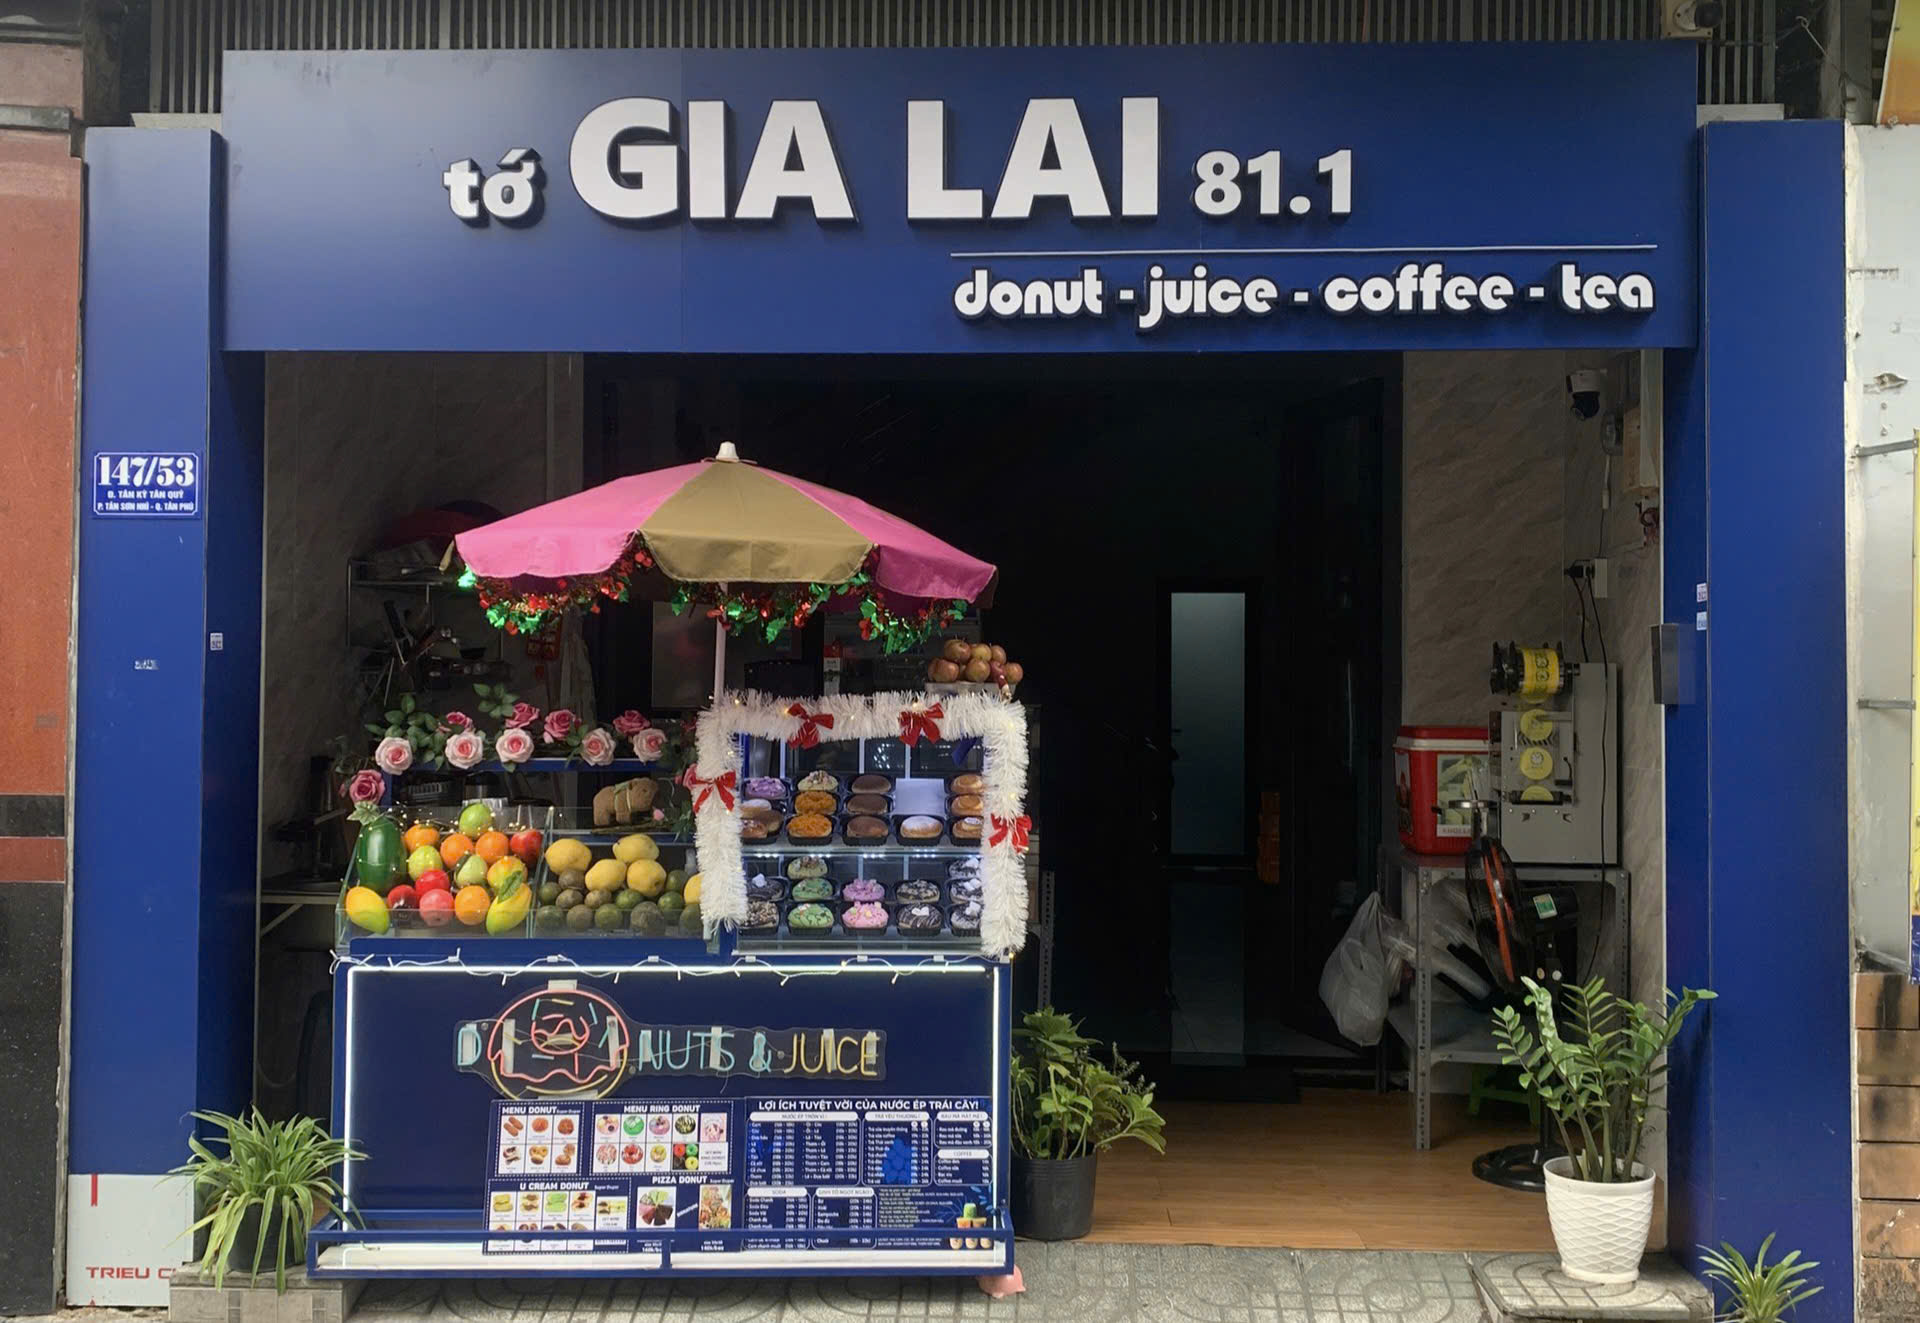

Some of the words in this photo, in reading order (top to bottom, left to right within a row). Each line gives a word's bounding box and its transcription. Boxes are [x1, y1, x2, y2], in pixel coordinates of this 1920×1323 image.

[443, 148, 536, 218] tớ
[570, 98, 855, 219] GIA
[907, 97, 1159, 219] LAI
[1193, 149, 1352, 215] 81.1
[954, 269, 1103, 316] donut
[1139, 265, 1278, 329] juice
[1324, 264, 1515, 312] coffee
[1562, 264, 1653, 310] tea
[98, 456, 195, 487] 147/53
[118, 489, 135, 499] TÂN
[149, 489, 166, 499] TÂN
[97, 502, 104, 511] P.
[105, 501, 119, 511] TÂN
[120, 502, 135, 511] SƠN
[164, 501, 178, 511] TÂN
[783, 1030, 881, 1076] JUICE
[501, 1106, 527, 1115] MENU
[528, 1106, 558, 1114] DONUT
[623, 1105, 648, 1113] MENU
[649, 1104, 670, 1113] RING
[671, 1104, 701, 1113] DONUT
[758, 1101, 776, 1112] LỢI
[779, 1099, 797, 1110] ÍCH
[799, 1099, 832, 1112] TUYỆT
[834, 1099, 853, 1110] VỜI
[855, 1099, 878, 1110] CỦA
[879, 1099, 910, 1110] NƯỚC
[912, 1099, 927, 1110] ÉP
[929, 1099, 953, 1110] TRÁI
[955, 1099, 979, 1110] CÂY!
[652, 1175, 677, 1184] PIZZA
[678, 1175, 708, 1184] DONUT
[519, 1182, 527, 1191] U
[528, 1182, 559, 1191] CREAM
[560, 1181, 590, 1190] DONUT
[86, 1266, 150, 1280] TRIEU
